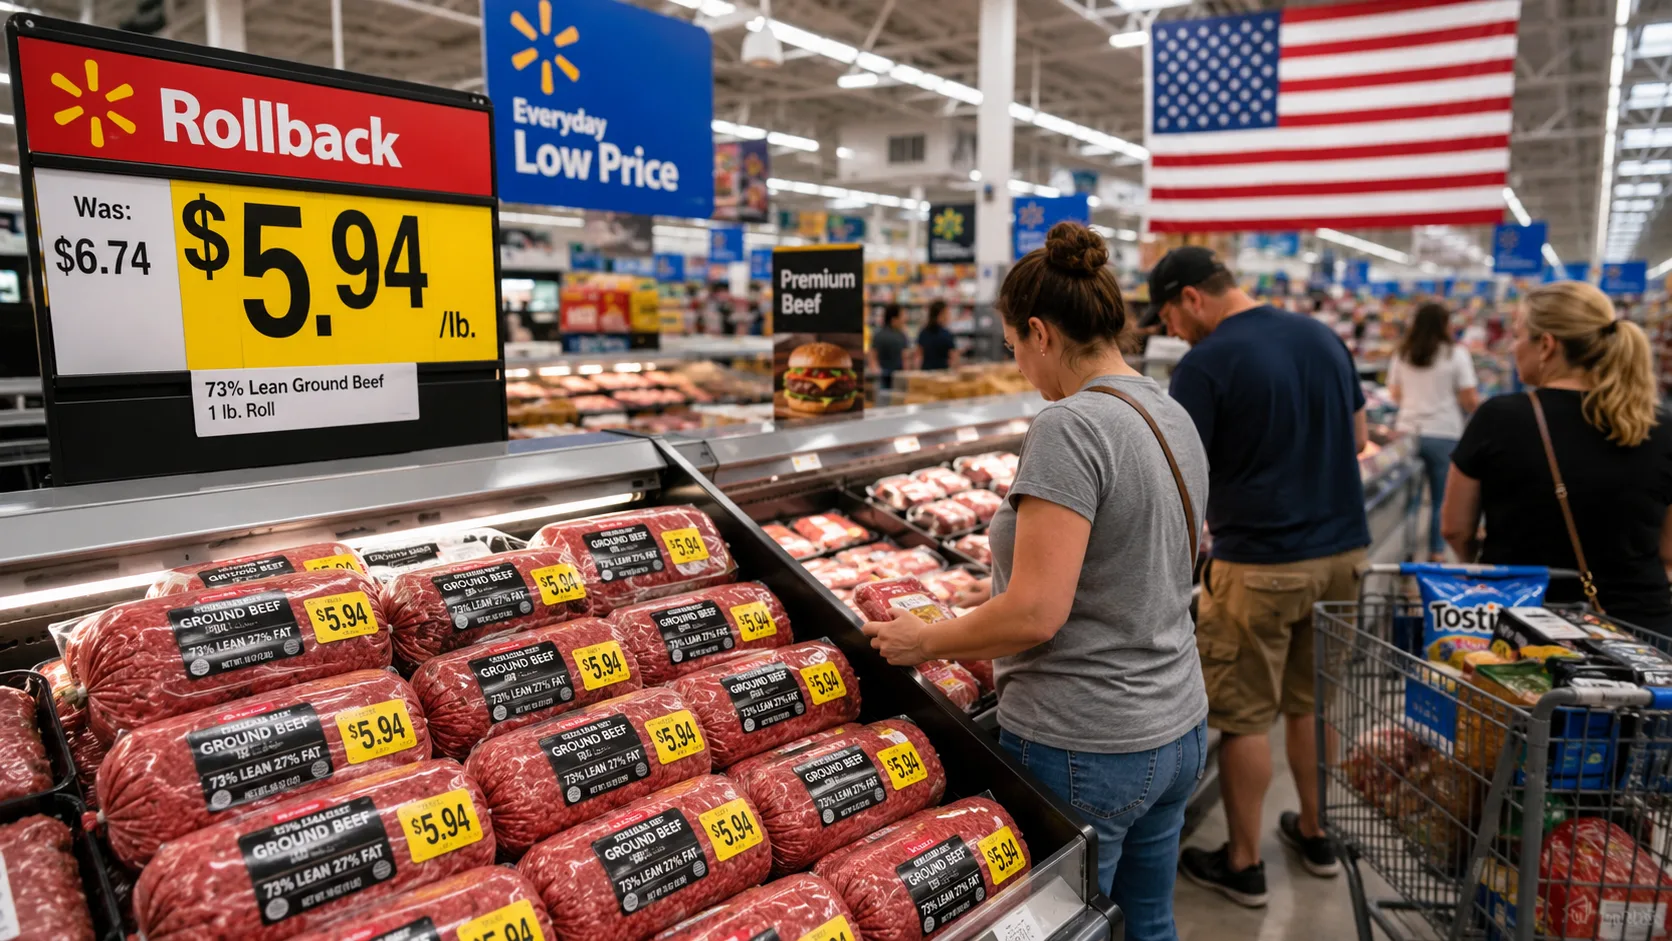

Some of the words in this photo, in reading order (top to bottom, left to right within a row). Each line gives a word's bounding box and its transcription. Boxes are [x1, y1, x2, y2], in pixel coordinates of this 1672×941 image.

[159, 87, 402, 168] Rollback
[512, 96, 608, 142] Everyday
[514, 129, 593, 181] Low
[598, 142, 680, 192] Price
[73, 195, 132, 220] Was:
[54, 235, 151, 276] $6.74
[181, 193, 428, 338] $5.94
[780, 267, 856, 289] Premium
[781, 292, 822, 315] Beef
[439, 309, 477, 339] /lb.
[205, 380, 244, 397] 73%
[250, 379, 288, 395] Lean
[293, 375, 348, 393] Ground
[353, 374, 384, 389] Beef
[208, 405, 216, 420] 1
[222, 404, 242, 420] lb.
[247, 401, 275, 418] Roll
[670, 536, 701, 556] $5.94
[492, 570, 514, 582] BEEF
[540, 572, 580, 596] $5.94
[180, 608, 245, 628] GROUND
[249, 600, 281, 616] BEEF
[316, 602, 368, 631] $5.94
[472, 597, 493, 612] LEAN
[1430, 602, 1497, 631] Tosti
[740, 610, 770, 632] $5.94
[188, 644, 214, 658] 73%
[216, 636, 246, 652] LEAN
[247, 632, 272, 646] 27%
[273, 627, 292, 640] FAT
[480, 658, 528, 678] GROUND
[532, 651, 554, 665] BEEF
[582, 650, 622, 679] $5.94
[510, 686, 532, 700] LEAN
[551, 675, 566, 686] FAT
[808, 670, 839, 695] $5.94
[200, 726, 271, 755] GROUND
[274, 716, 311, 735] BEEF
[348, 712, 405, 749] $5.94
[551, 733, 601, 758] GROUND
[603, 724, 628, 741] BEEF
[655, 720, 696, 752] $5.94
[209, 772, 238, 789] 73%
[240, 761, 272, 781] LEAN
[274, 752, 300, 770] 27%
[301, 746, 321, 762] FAT
[563, 771, 585, 786] 73%
[584, 762, 607, 780] LEAN
[608, 756, 626, 770] 27%
[626, 750, 641, 763] FAT
[805, 762, 844, 782] GROUND
[886, 752, 920, 778] $5.94
[252, 824, 329, 860] GROUND
[332, 810, 371, 834] BEEF
[411, 803, 470, 844] $5.94
[711, 810, 754, 846] $5.94
[604, 832, 656, 861] GROUND
[658, 819, 682, 839] BEEF
[987, 838, 1020, 872] $5.94
[263, 877, 295, 899] 73%
[295, 863, 331, 887] LEAN
[332, 853, 360, 874] 27%
[361, 844, 384, 862] FAT
[641, 866, 664, 884] LEAN
[662, 856, 683, 872] 27%
[682, 847, 698, 863] FAT
[908, 860, 946, 886] GROUND
[948, 846, 966, 866] BEEF
[968, 873, 980, 888] FAT
